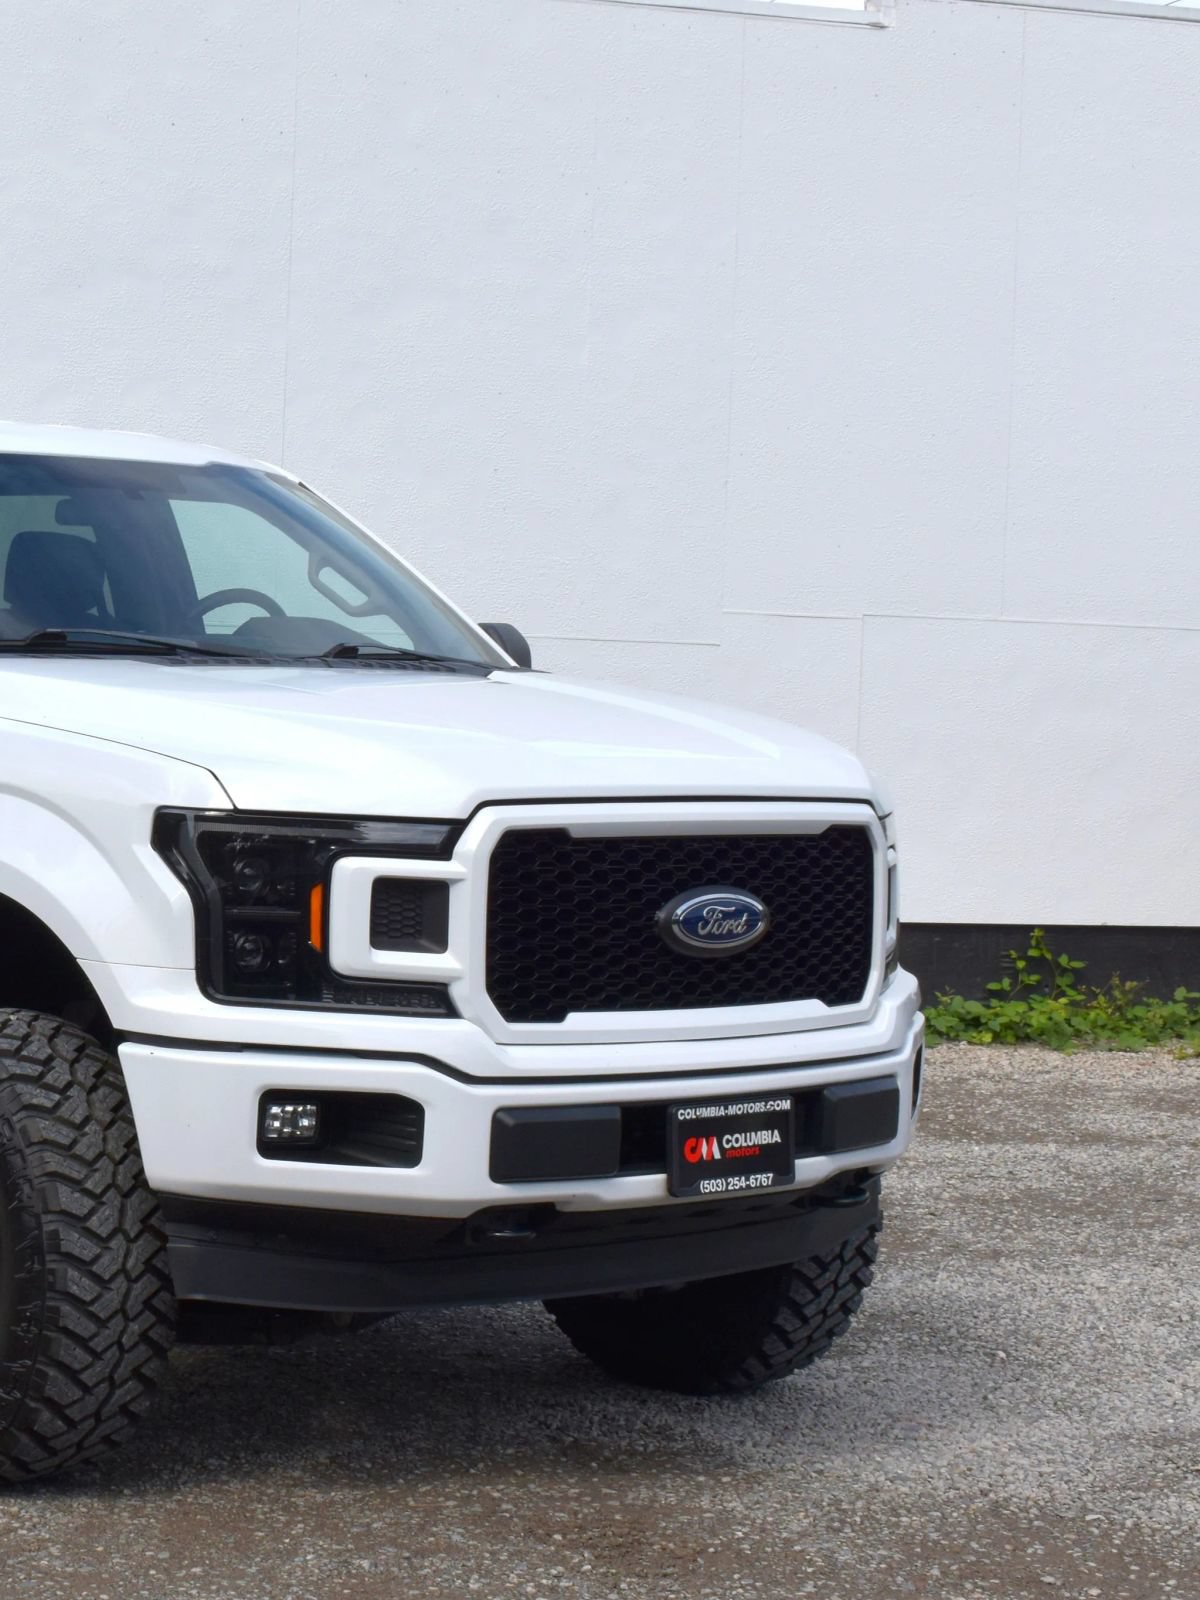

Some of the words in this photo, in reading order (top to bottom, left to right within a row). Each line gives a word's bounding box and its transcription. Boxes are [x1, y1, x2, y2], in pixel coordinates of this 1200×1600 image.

[698, 905, 748, 935] Ford
[677, 1100, 791, 1120] COLUMBIA-MOTORS.COM
[722, 1129, 781, 1148] COLUMBIA
[725, 1145, 761, 1158] motors
[700, 1179, 726, 1193] (503)
[728, 1173, 773, 1190] 254-6767
